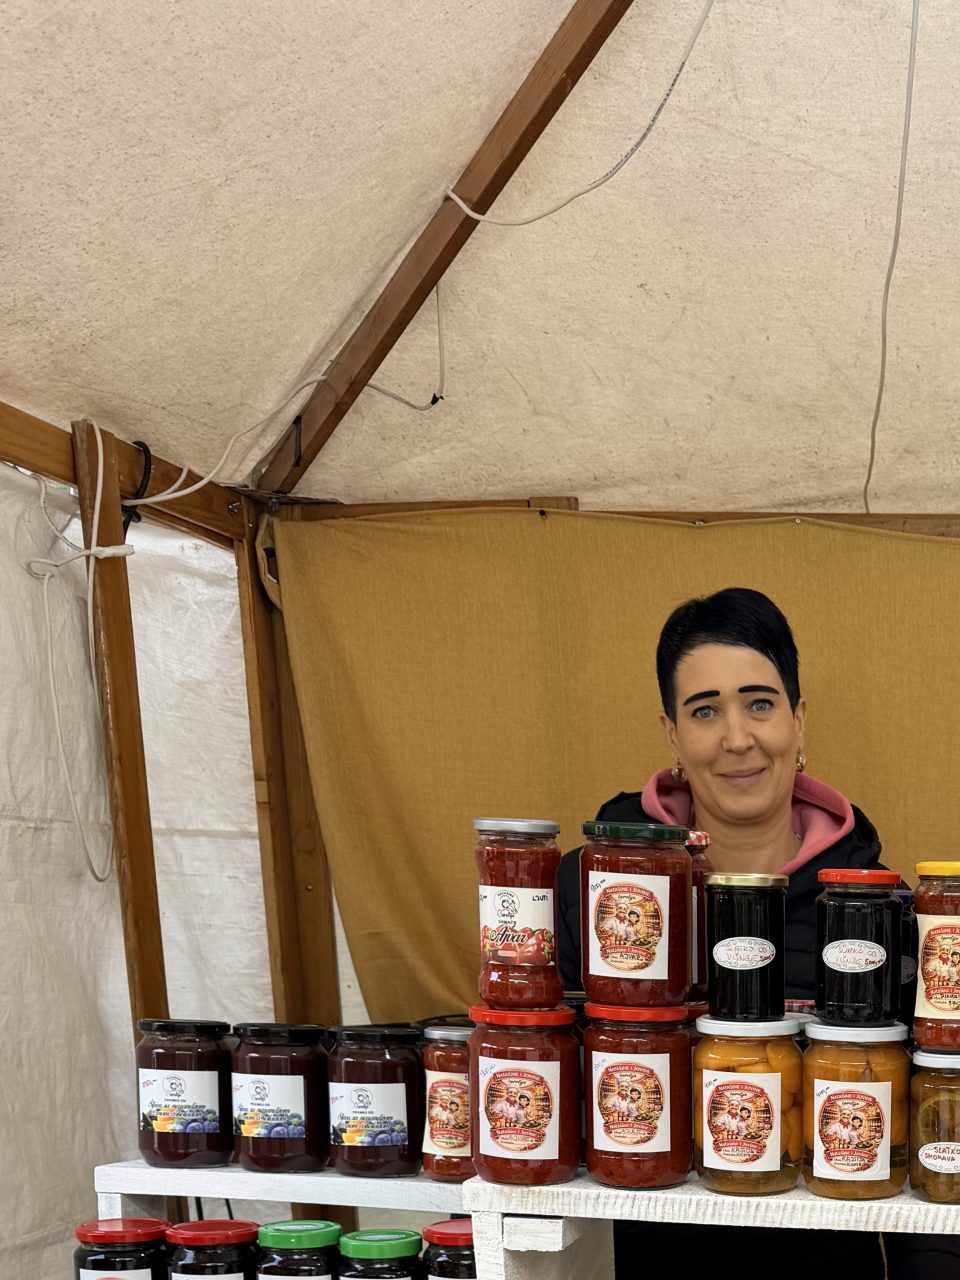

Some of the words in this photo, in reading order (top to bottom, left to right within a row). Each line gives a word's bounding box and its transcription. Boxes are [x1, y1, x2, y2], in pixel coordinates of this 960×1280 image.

[489, 927, 526, 946] Ajvar
[933, 1147, 960, 1155] SLATKO
[925, 1153, 956, 1162] SMOKAVA
